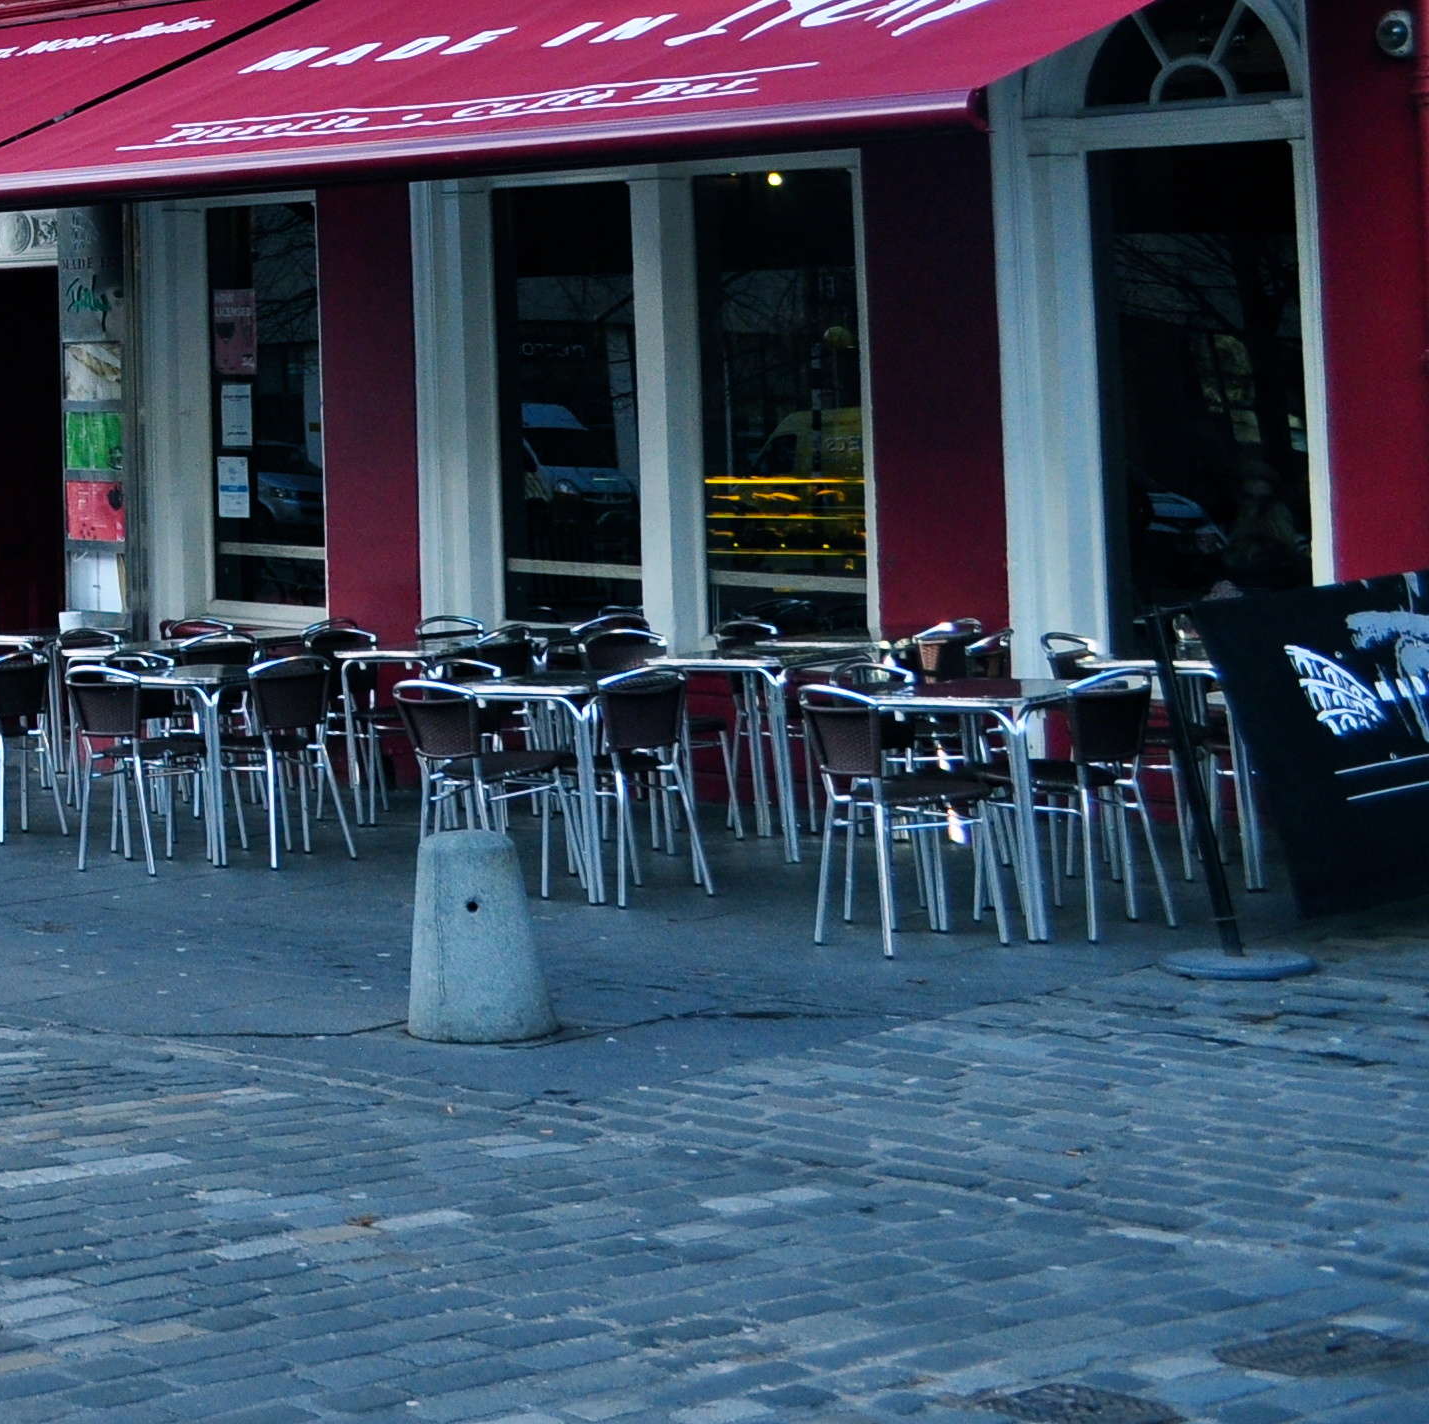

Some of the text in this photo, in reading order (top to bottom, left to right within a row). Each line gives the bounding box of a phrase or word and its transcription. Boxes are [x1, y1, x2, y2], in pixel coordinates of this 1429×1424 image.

[237, 26, 519, 74] MADE
[540, 13, 679, 47] IN
[155, 114, 373, 143] Pizzeria
[632, 77, 758, 102] Bar
